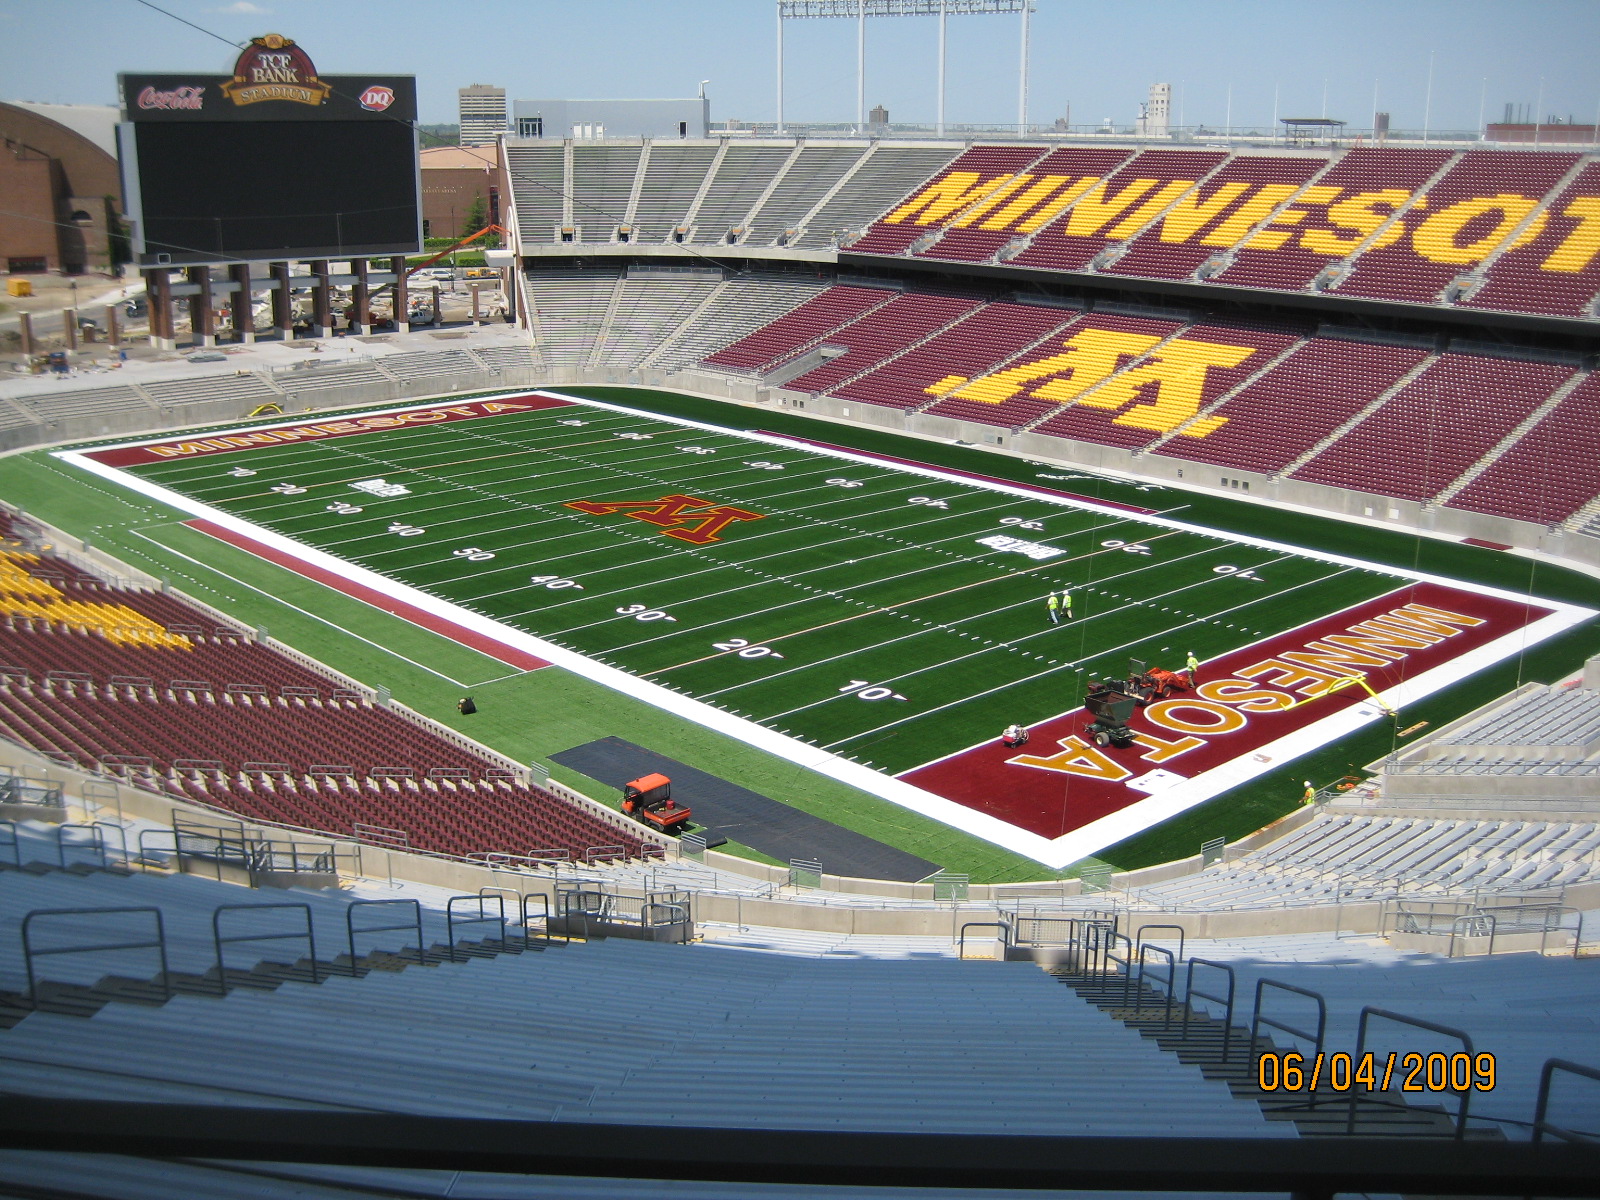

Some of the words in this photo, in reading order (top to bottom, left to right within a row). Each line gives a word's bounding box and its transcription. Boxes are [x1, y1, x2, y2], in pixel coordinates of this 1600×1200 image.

[258, 54, 291, 69] TCF
[252, 67, 299, 83] BANK
[241, 86, 312, 102] STADIUM
[366, 92, 390, 107] DQ
[144, 401, 533, 458] MINNESOTA
[271, 483, 307, 495] 20
[825, 478, 864, 488] 50
[326, 501, 363, 515] 30
[908, 497, 948, 508] 40
[388, 523, 425, 536] 40
[999, 517, 1044, 530] 30
[1100, 540, 1150, 553] 20
[453, 547, 496, 562] 50
[1212, 565, 1255, 578] 10
[530, 575, 575, 590] 40
[616, 604, 666, 621] 30
[712, 638, 772, 659] 20
[839, 679, 893, 700] 10
[1004, 602, 1488, 781] MINNESOTA
